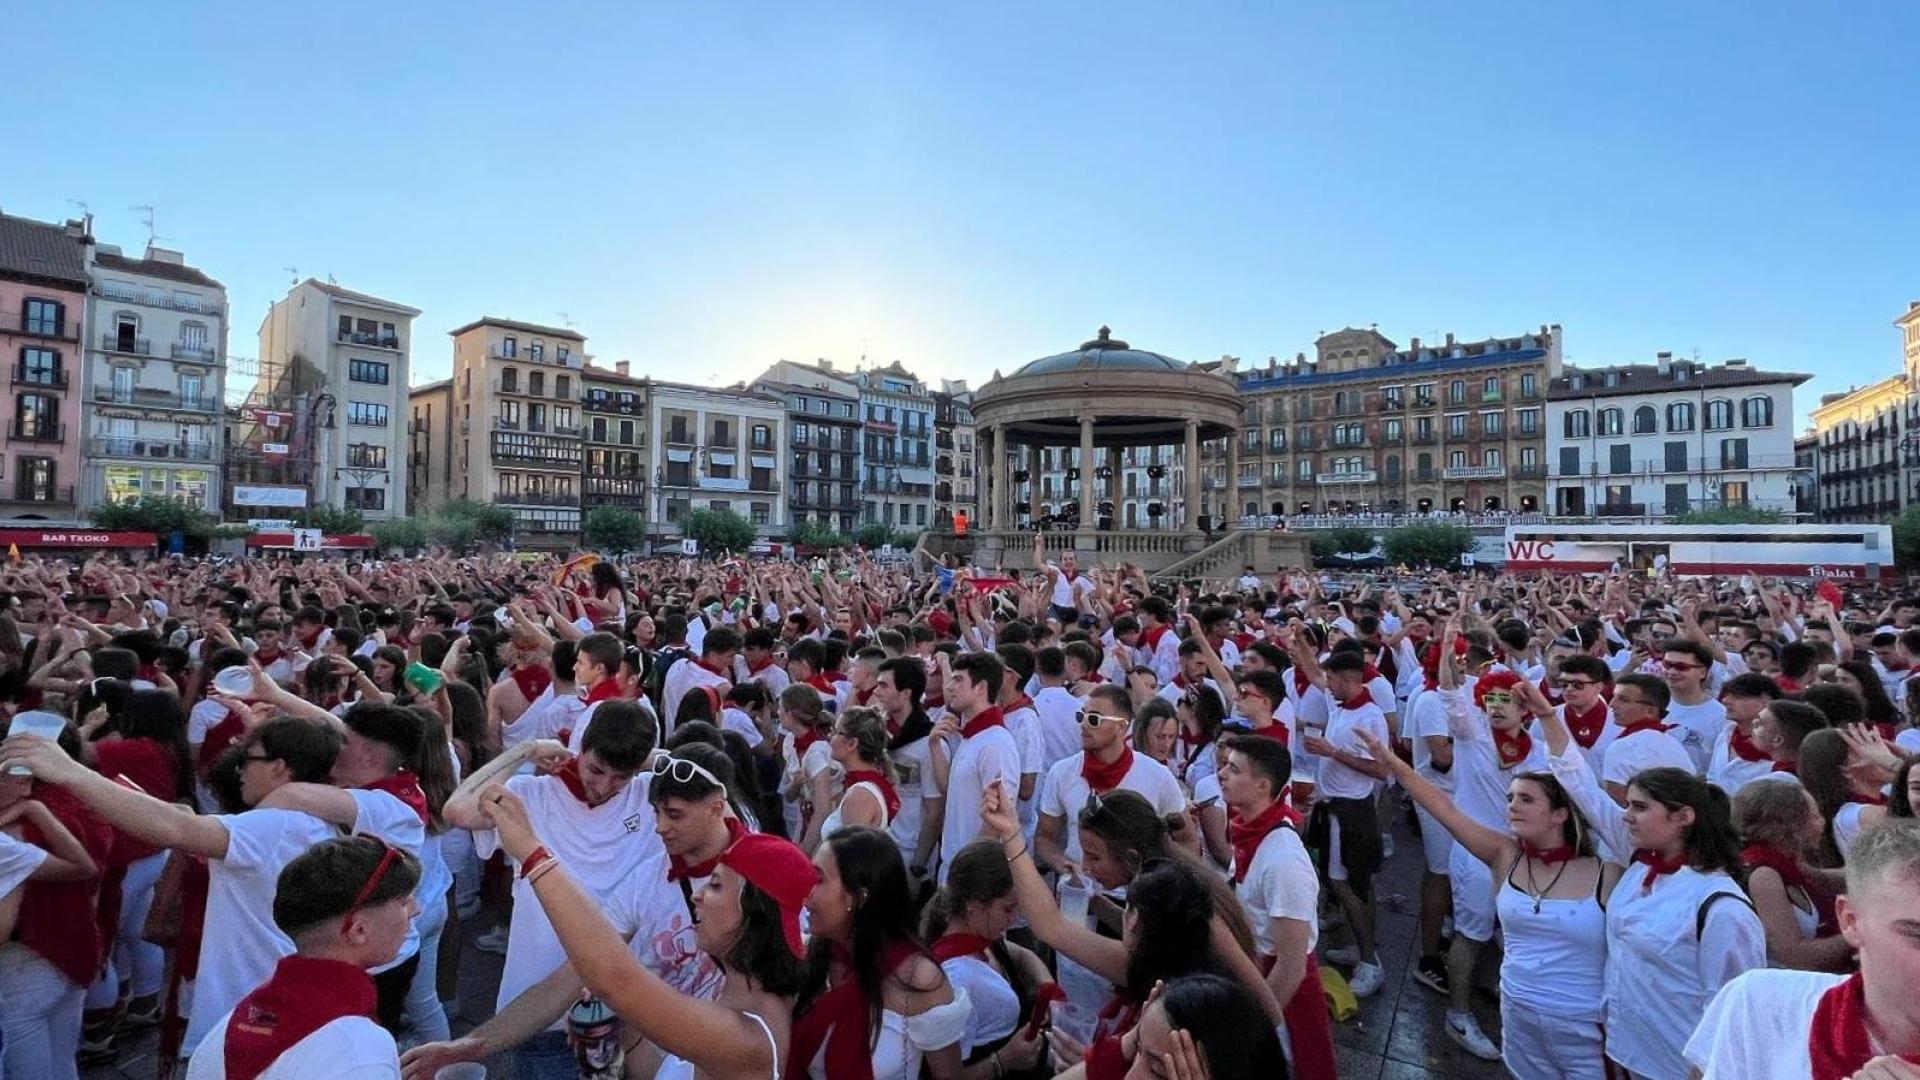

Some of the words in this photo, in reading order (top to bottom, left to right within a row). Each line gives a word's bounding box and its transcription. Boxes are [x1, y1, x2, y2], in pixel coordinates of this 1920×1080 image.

[42, 534, 66, 542] BAR
[69, 534, 110, 542] TXOKO
[1507, 541, 1555, 560] WC
